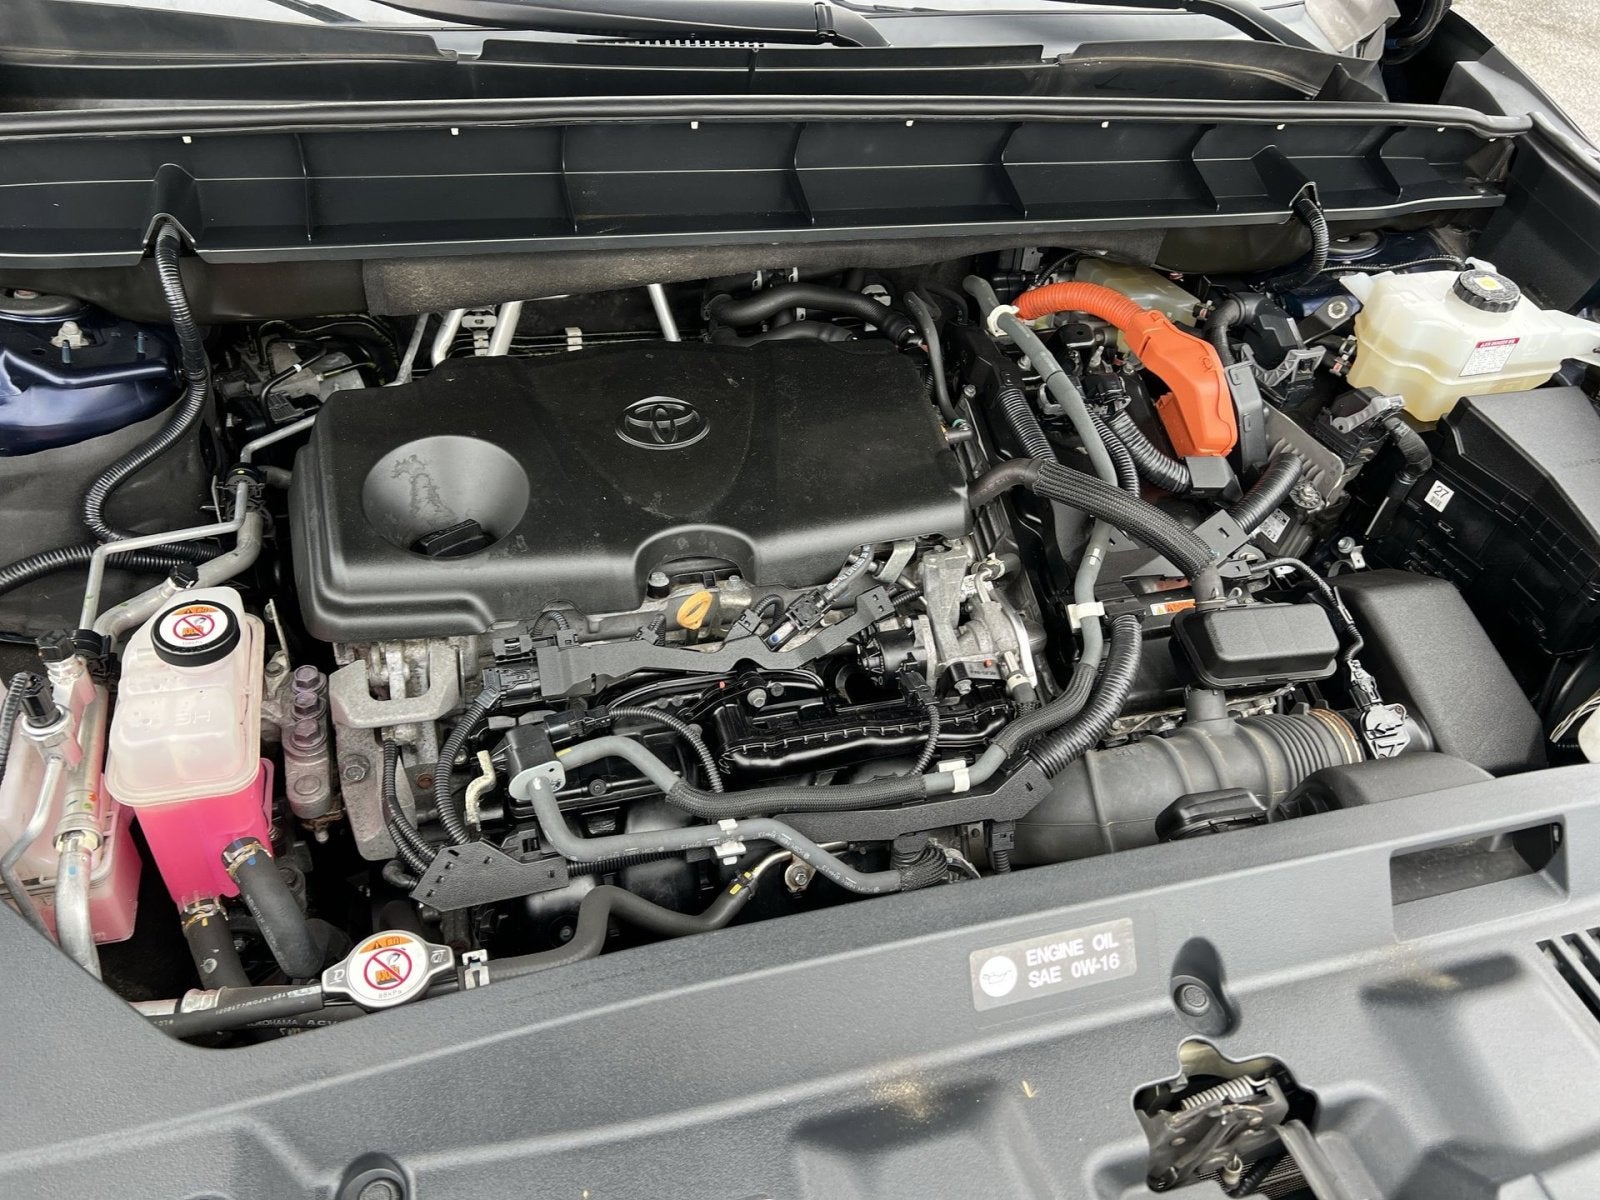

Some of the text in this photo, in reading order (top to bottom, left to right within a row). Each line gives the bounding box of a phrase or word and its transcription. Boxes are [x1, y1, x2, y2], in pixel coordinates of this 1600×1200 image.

[1433, 485, 1449, 498] 27
[1025, 932, 1119, 967] ENGINE OIL
[1027, 952, 1121, 988] SAE 0W-16
